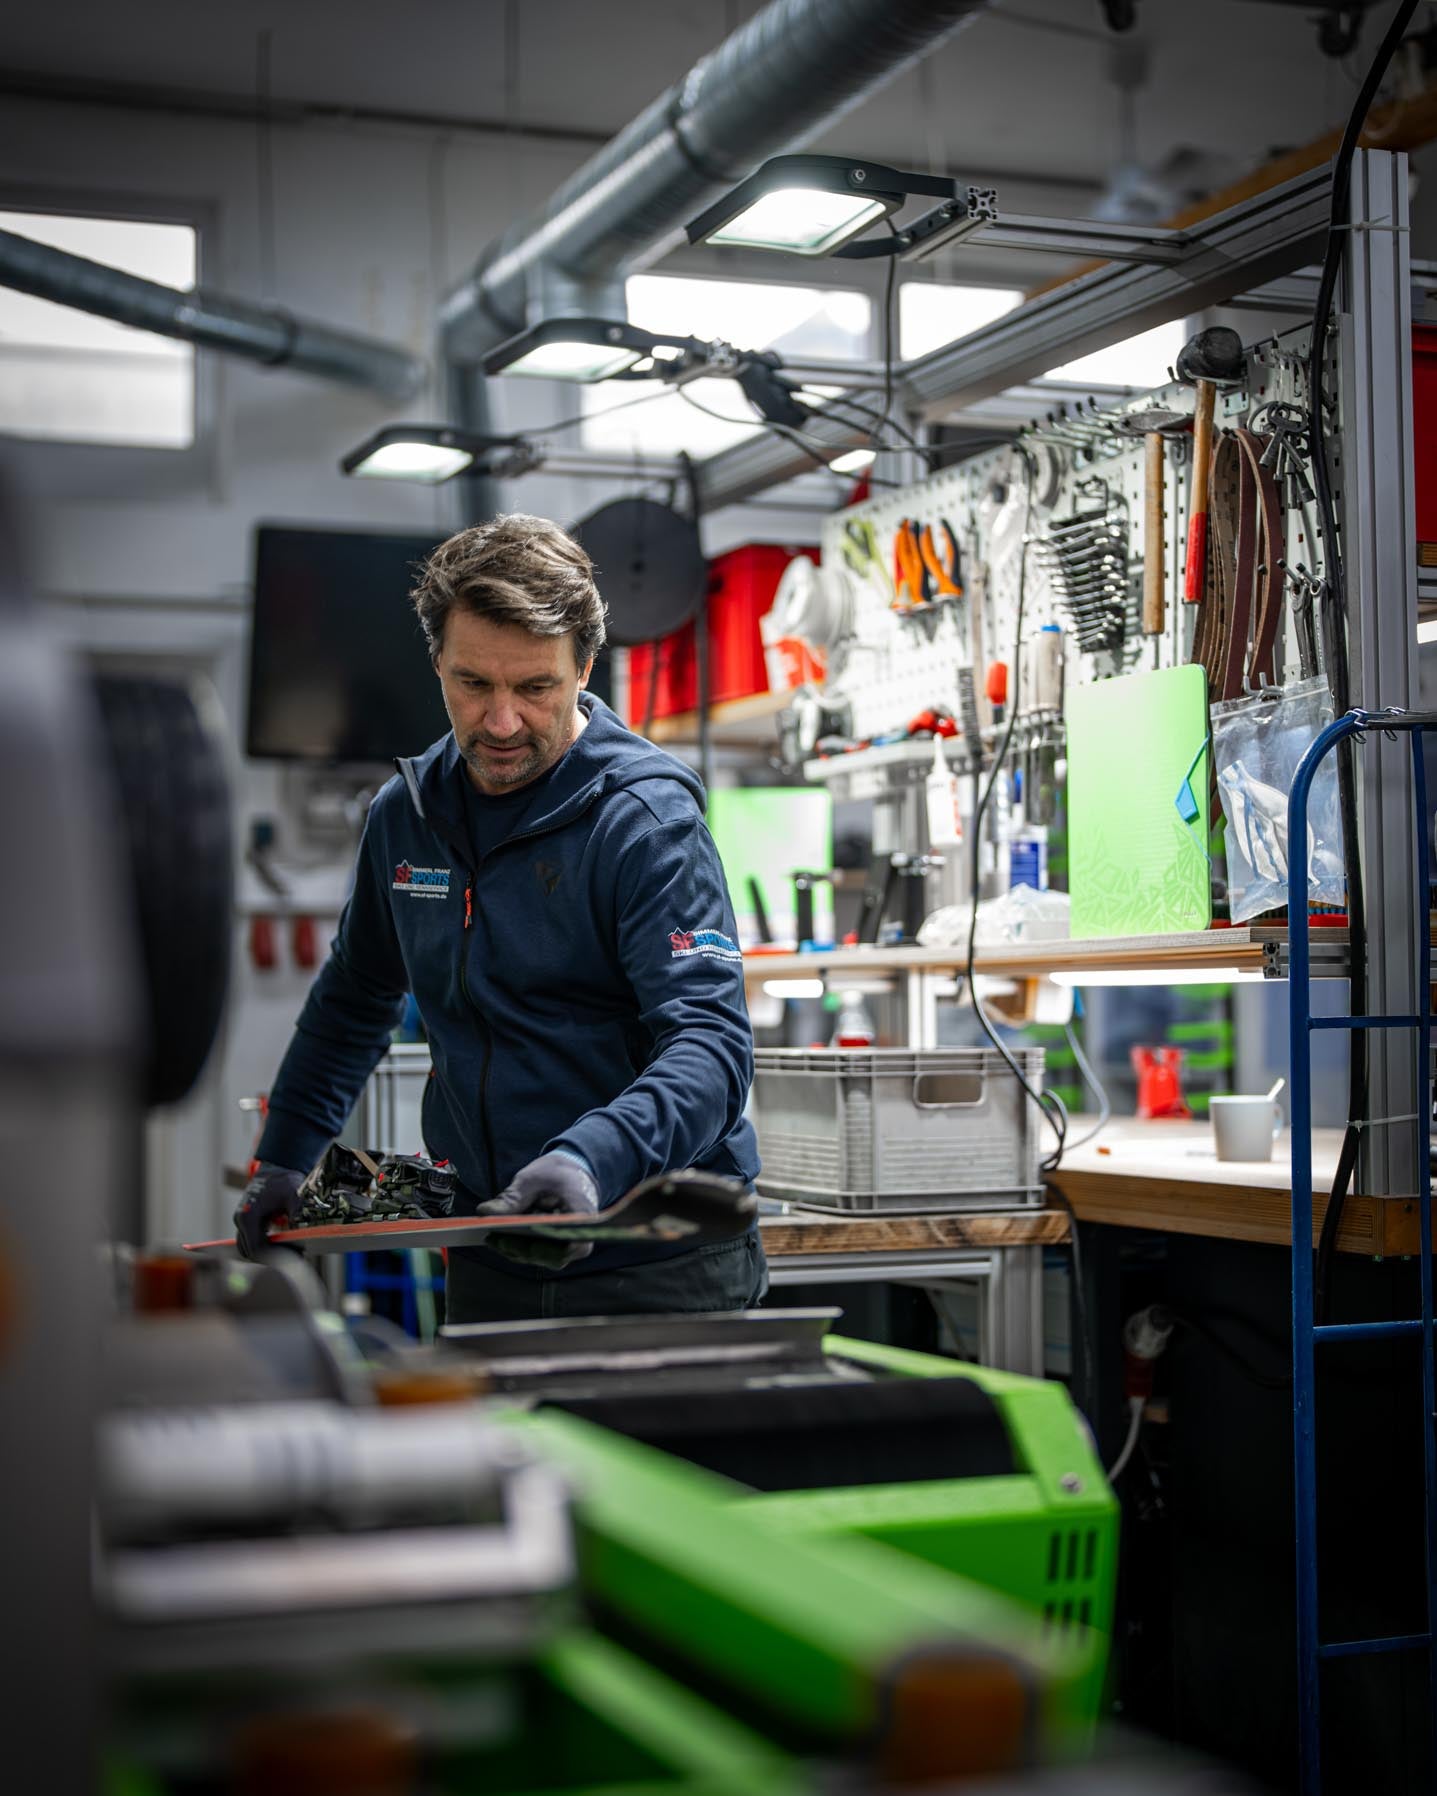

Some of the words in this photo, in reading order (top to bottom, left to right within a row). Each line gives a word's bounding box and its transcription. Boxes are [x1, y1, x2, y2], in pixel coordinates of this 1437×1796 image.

[395, 866, 412, 883] SF
[411, 871, 449, 886] SPORTS
[671, 932, 694, 950] SF
